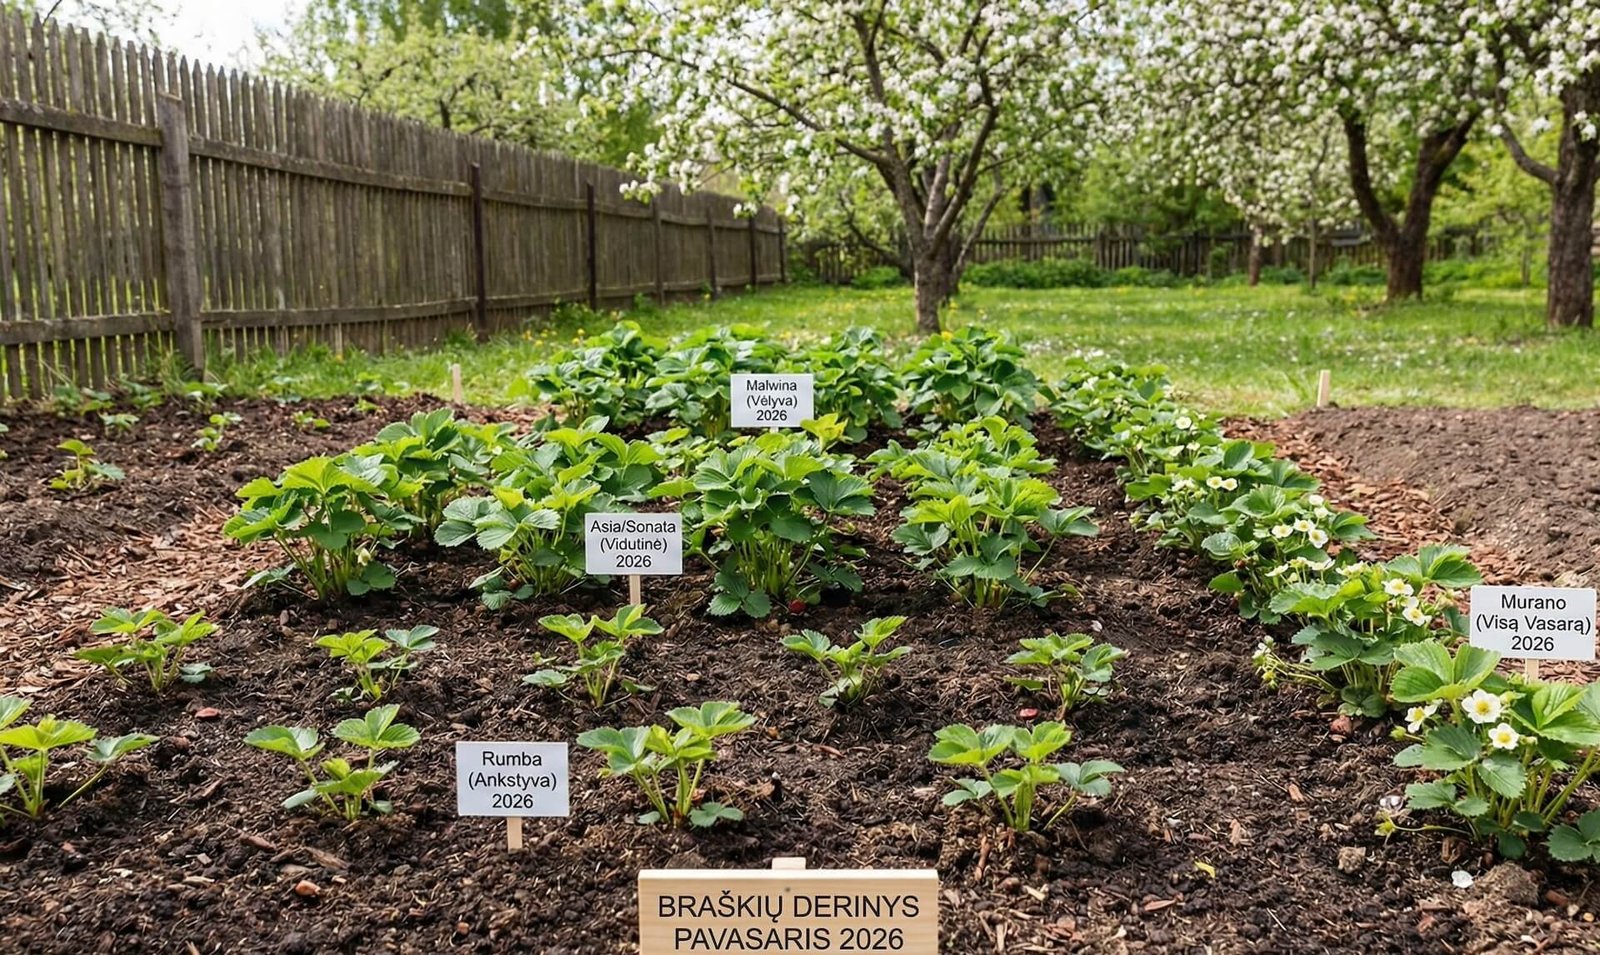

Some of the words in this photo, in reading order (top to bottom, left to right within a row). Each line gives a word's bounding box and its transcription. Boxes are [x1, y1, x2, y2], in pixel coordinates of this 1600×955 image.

[746, 379, 798, 392] Malwina
[746, 395, 799, 410] (Vėlyva)
[757, 409, 788, 422] 2026
[590, 519, 676, 533] Asia/Sonata
[600, 537, 668, 554] (Vidutinė)
[615, 554, 652, 568] 2026
[1501, 593, 1567, 610] Murano
[1476, 613, 1519, 633] (Visą
[1524, 615, 1591, 636] Vasarą)
[1511, 635, 1555, 652] 2026
[482, 750, 543, 767] Rumba
[468, 771, 557, 791] (Ankstyva)
[491, 793, 534, 809] 2026
[658, 889, 783, 924] BRAŠKIŲ
[793, 894, 920, 918] DERINYS
[674, 927, 831, 951] PAVASARIS
[839, 927, 904, 951] 2026
